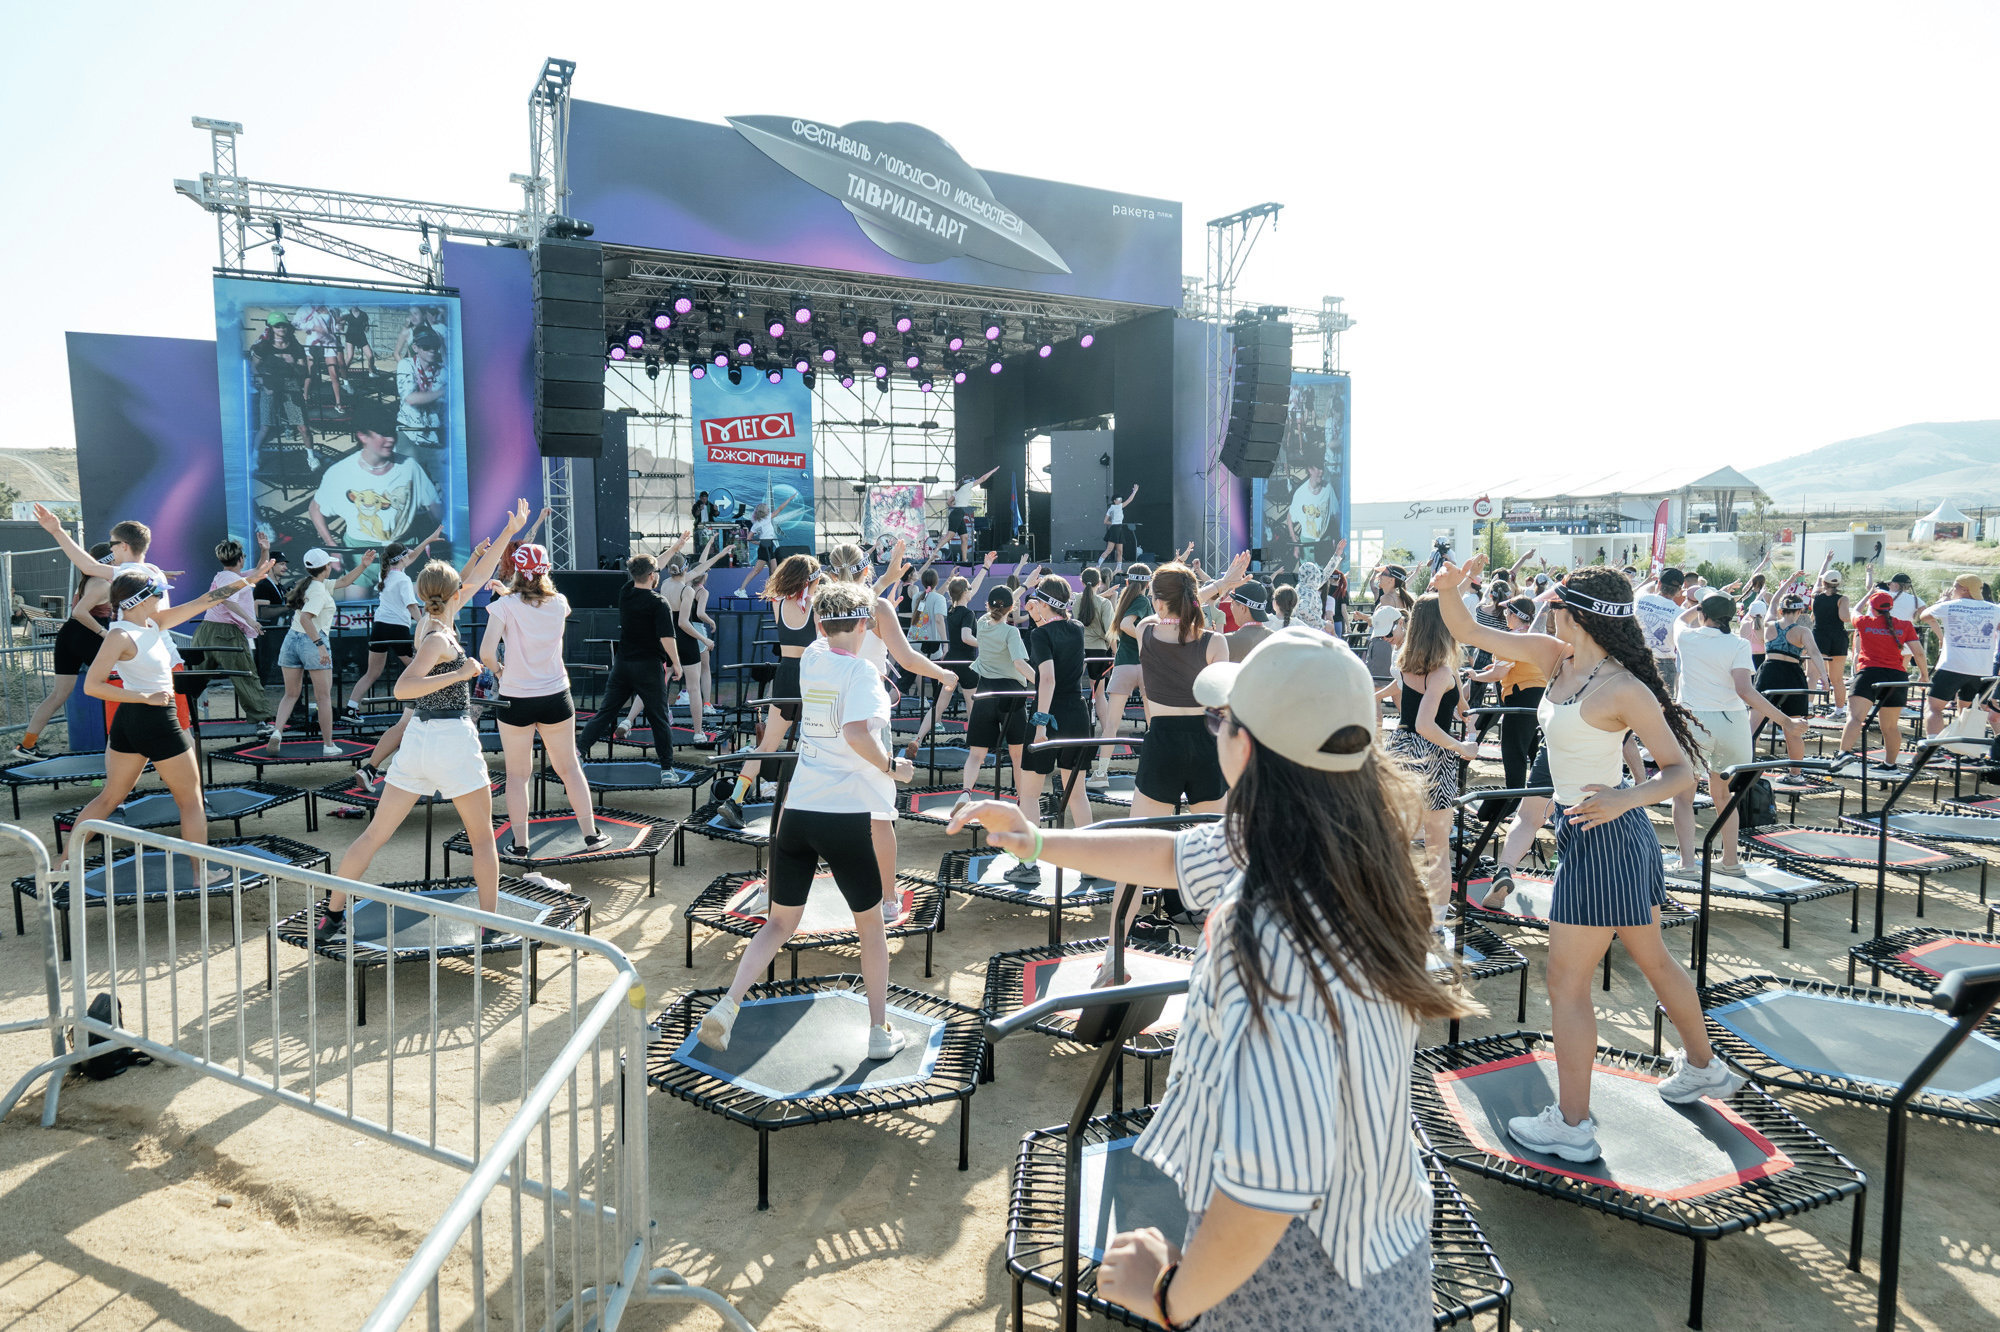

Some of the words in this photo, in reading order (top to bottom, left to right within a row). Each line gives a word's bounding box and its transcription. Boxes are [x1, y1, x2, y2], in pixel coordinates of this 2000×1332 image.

[791, 119, 872, 162] ФЕСТИВАЛЬ
[874, 151, 951, 197] МОЛОДОГО
[954, 187, 1023, 236] ИСКУССТВА
[847, 173, 968, 245] ТАВРИДА.АРТ
[1112, 204, 1155, 220] ракета
[705, 415, 791, 442] МЕГА
[710, 448, 804, 467] ДЖАМПИНГ
[1403, 502, 1434, 520] Spa
[1436, 505, 1470, 515] ЦЕНТР
[1048, 597, 1063, 608] STAY
[1592, 601, 1620, 615] STAY
[1623, 605, 1631, 615] IN
[850, 607, 869, 617] STYLE
[1864, 627, 1904, 636] РОССЯ
